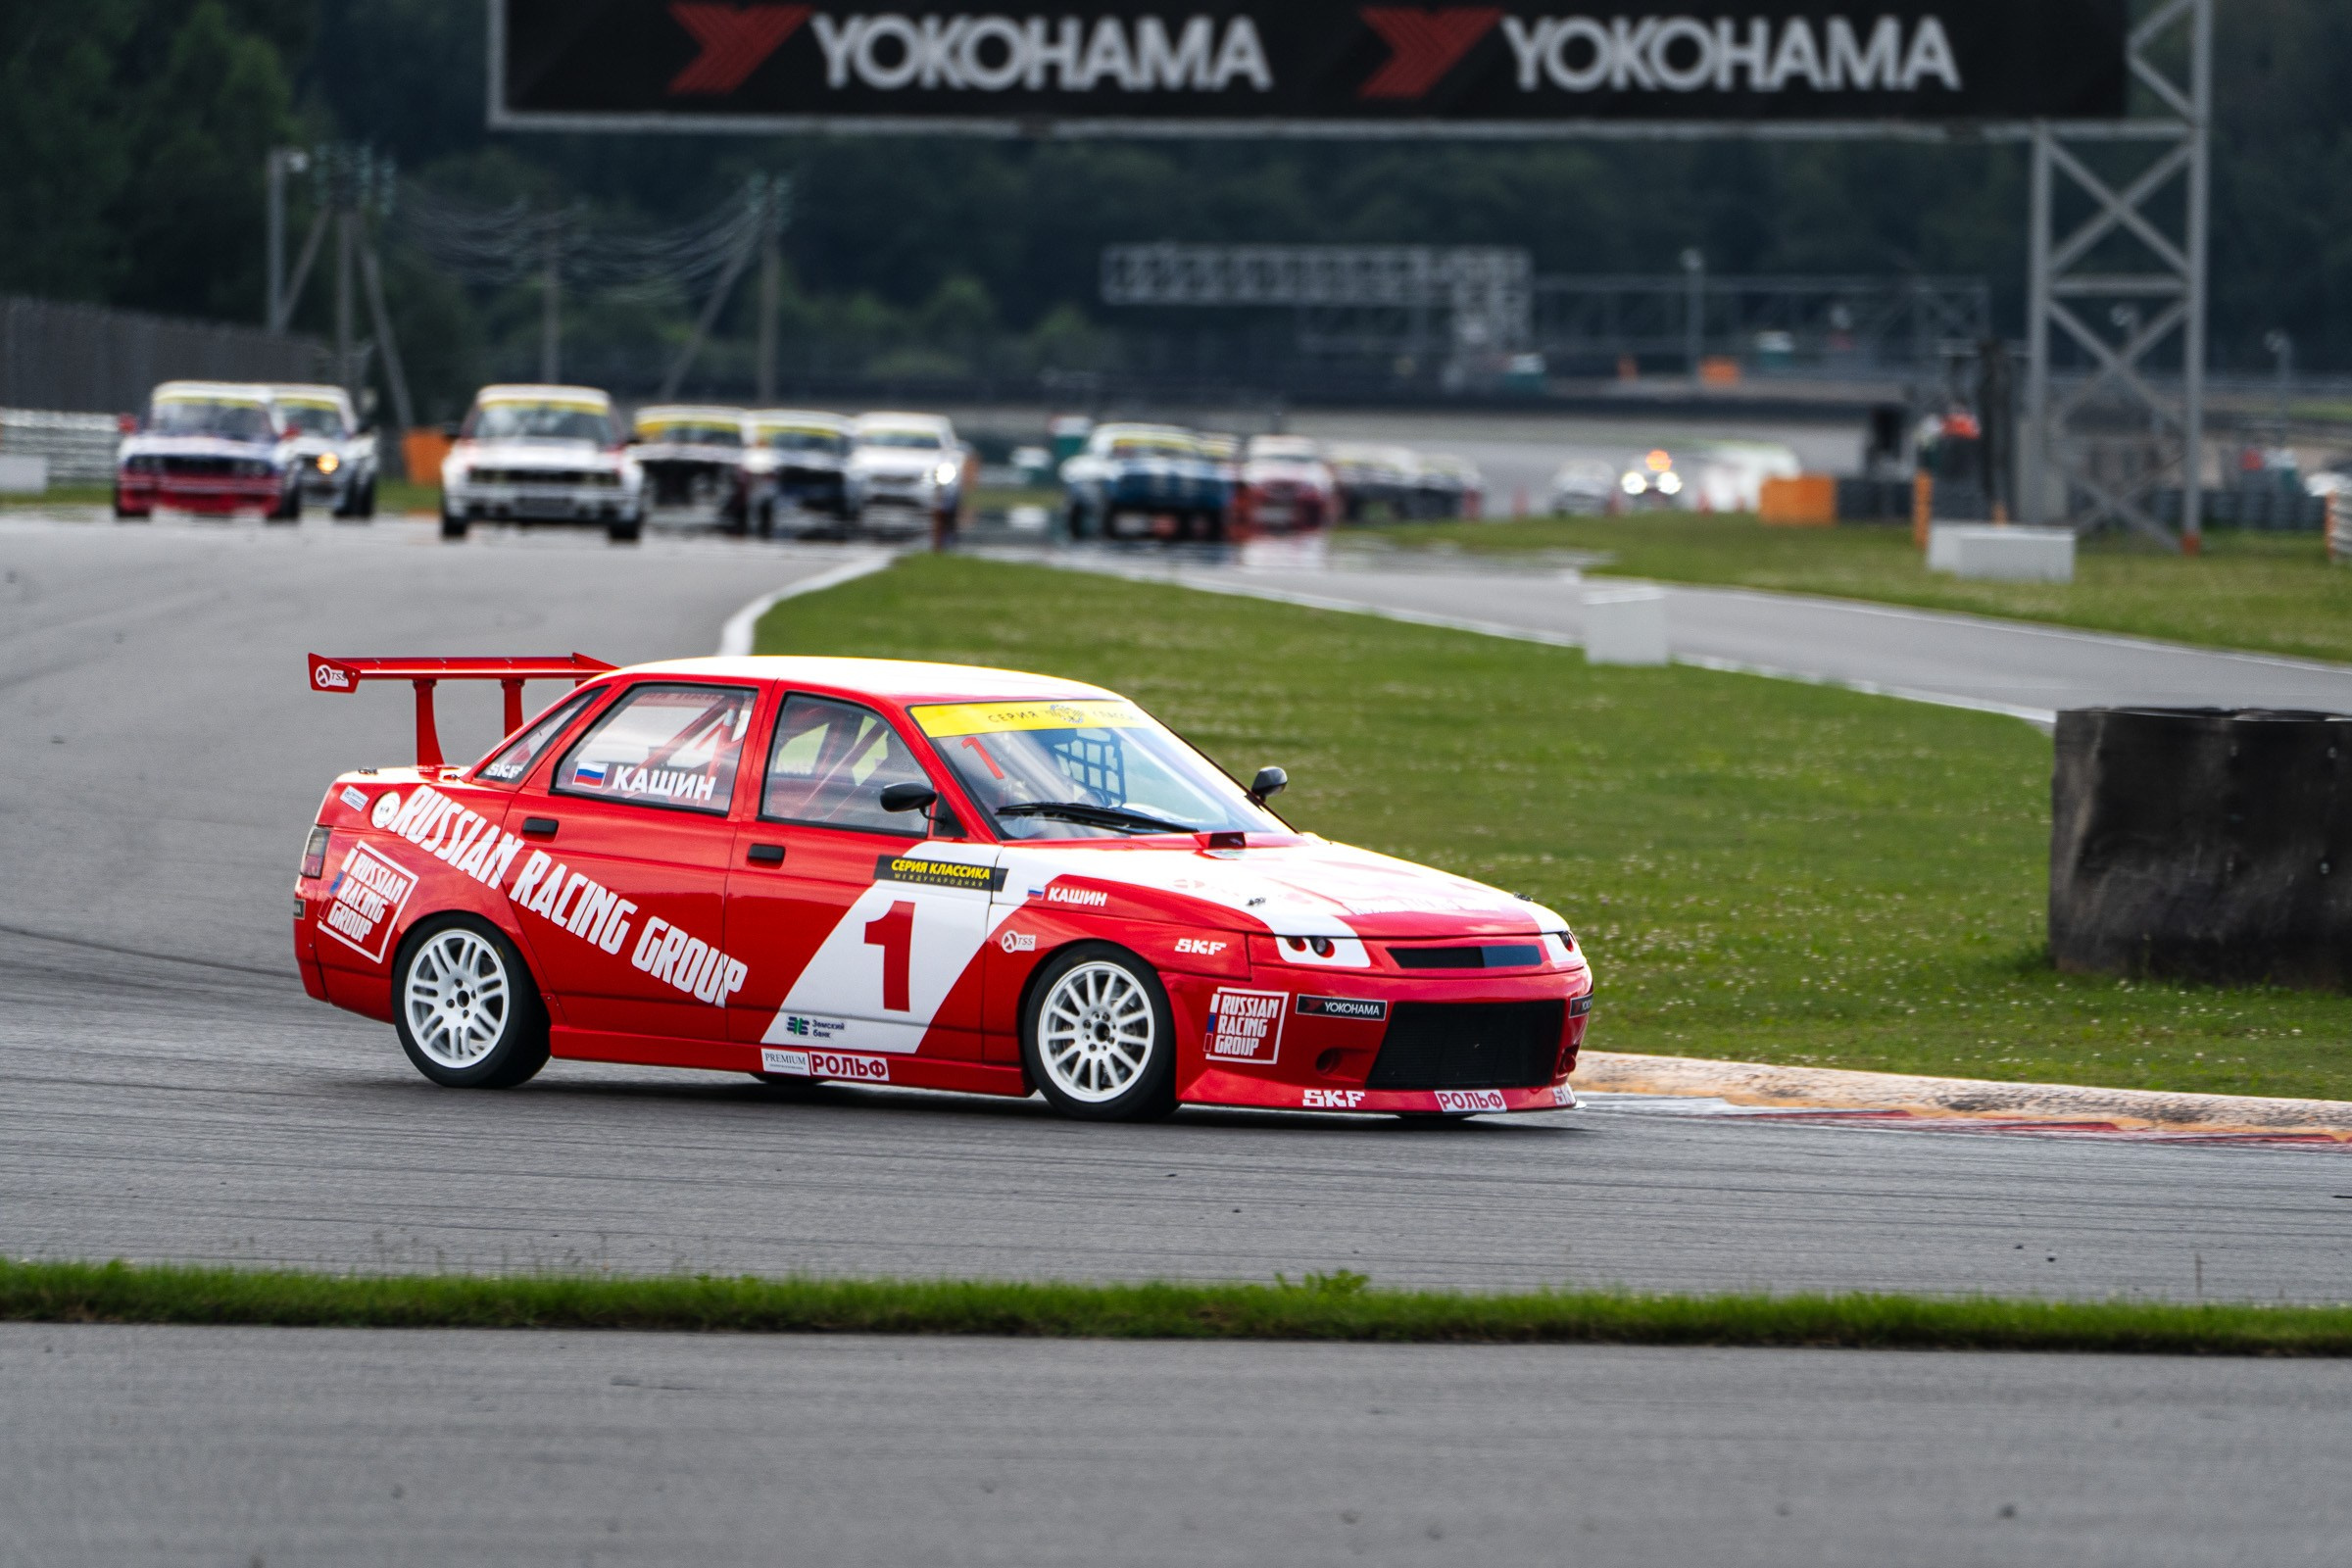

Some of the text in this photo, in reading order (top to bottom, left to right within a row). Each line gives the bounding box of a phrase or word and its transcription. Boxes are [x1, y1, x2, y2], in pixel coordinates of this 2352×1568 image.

[809, 14, 1273, 90] YOKOHAMA
[1500, 14, 1962, 91] YOKOHAMA
[988, 709, 1040, 724] СЕРИЯ
[485, 763, 523, 779] SKF
[612, 765, 716, 802] КАШИН
[350, 852, 409, 905] RUSSIAN
[891, 858, 991, 880] СЕРИЯ КЛАССИКА
[336, 875, 389, 924] RACING
[388, 785, 749, 1009] RUSSIAN RACING GROUP
[1048, 887, 1107, 907] КАШИН
[327, 901, 373, 944] GROUP
[863, 900, 915, 1013] 1
[1174, 938, 1227, 956] SKF
[1220, 995, 1280, 1018] RUSSIAN
[1324, 1002, 1380, 1016] YOKOHAMA
[812, 1019, 845, 1031] Земский
[812, 1029, 831, 1039] банк
[1217, 1014, 1268, 1038] RACING
[1214, 1034, 1259, 1056] GROUP
[764, 1053, 807, 1065] PREMIUM
[810, 1054, 887, 1078] РОЛЬФ
[1302, 1089, 1366, 1108] SKF
[1437, 1092, 1503, 1110] РОЛЬФ
